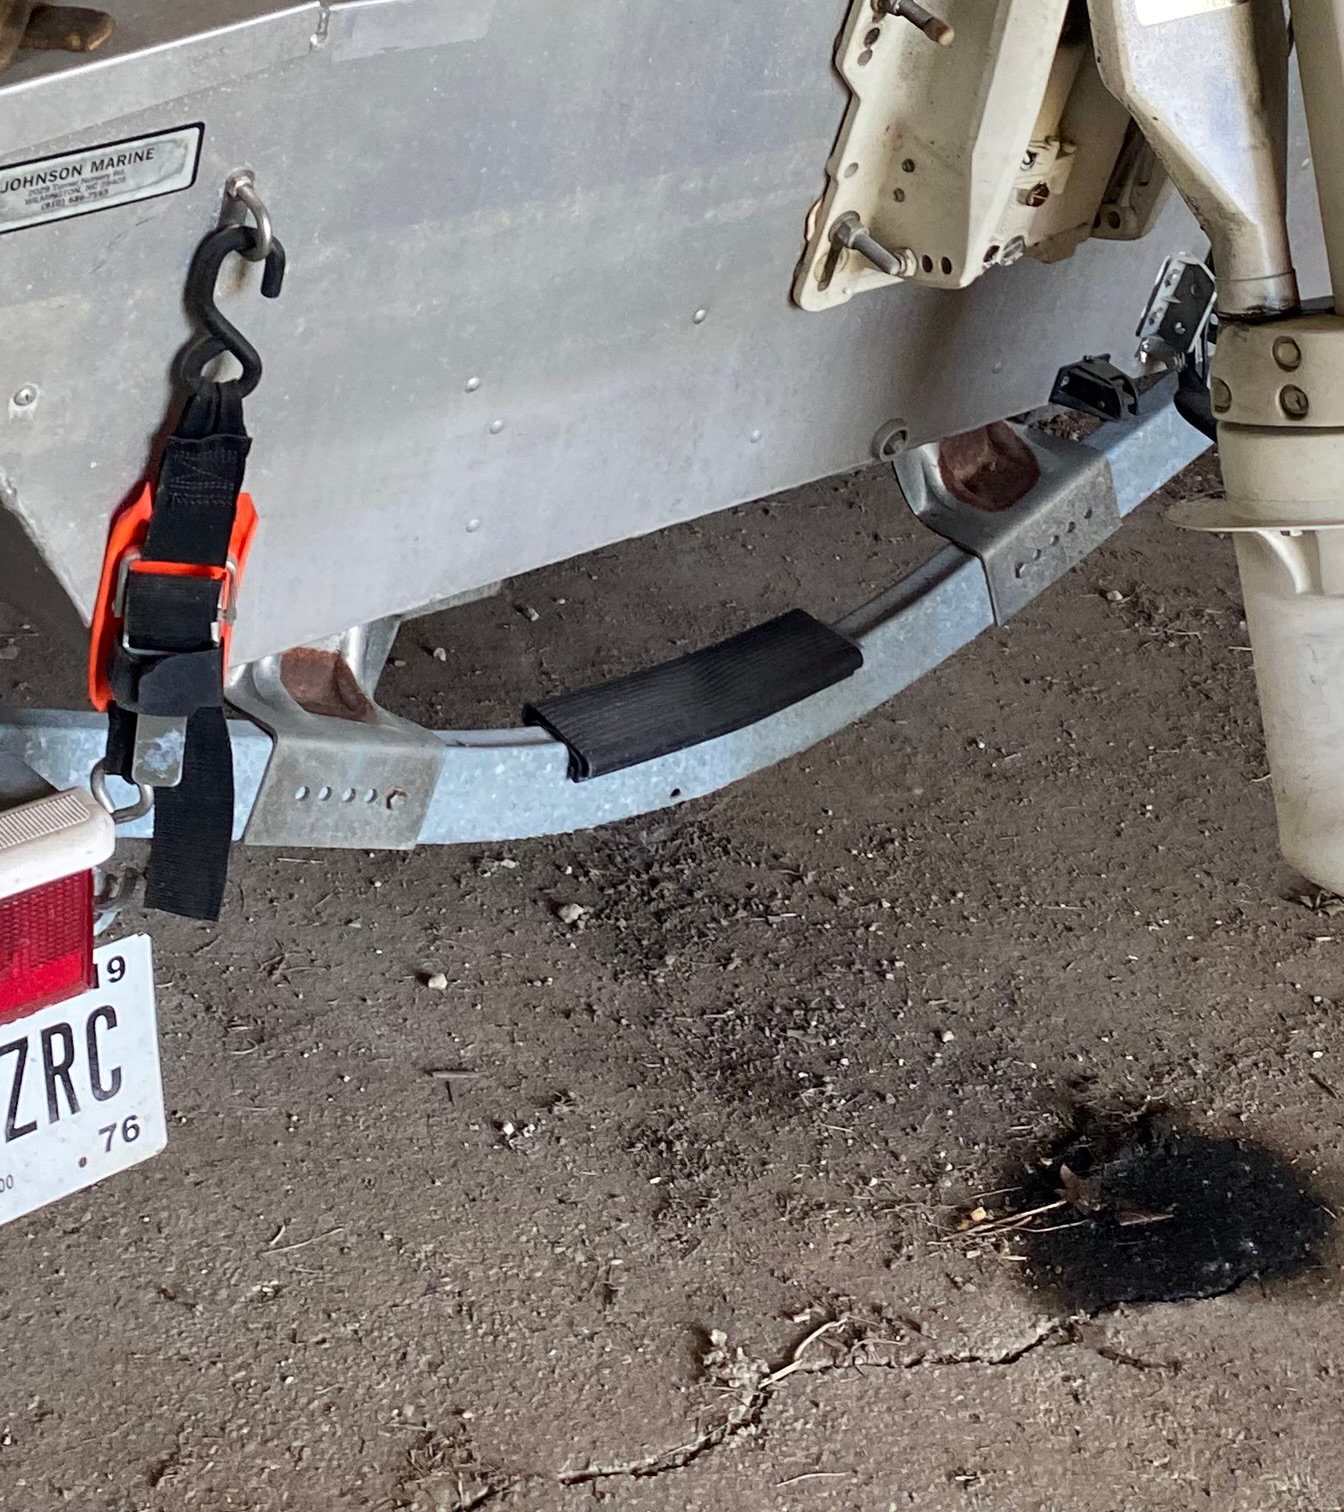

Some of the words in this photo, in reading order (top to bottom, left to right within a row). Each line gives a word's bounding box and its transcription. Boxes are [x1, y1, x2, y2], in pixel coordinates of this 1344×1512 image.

[0, 164, 84, 194] JOHNSON
[89, 148, 156, 174] MARINE
[98, 1114, 141, 1154] 76
